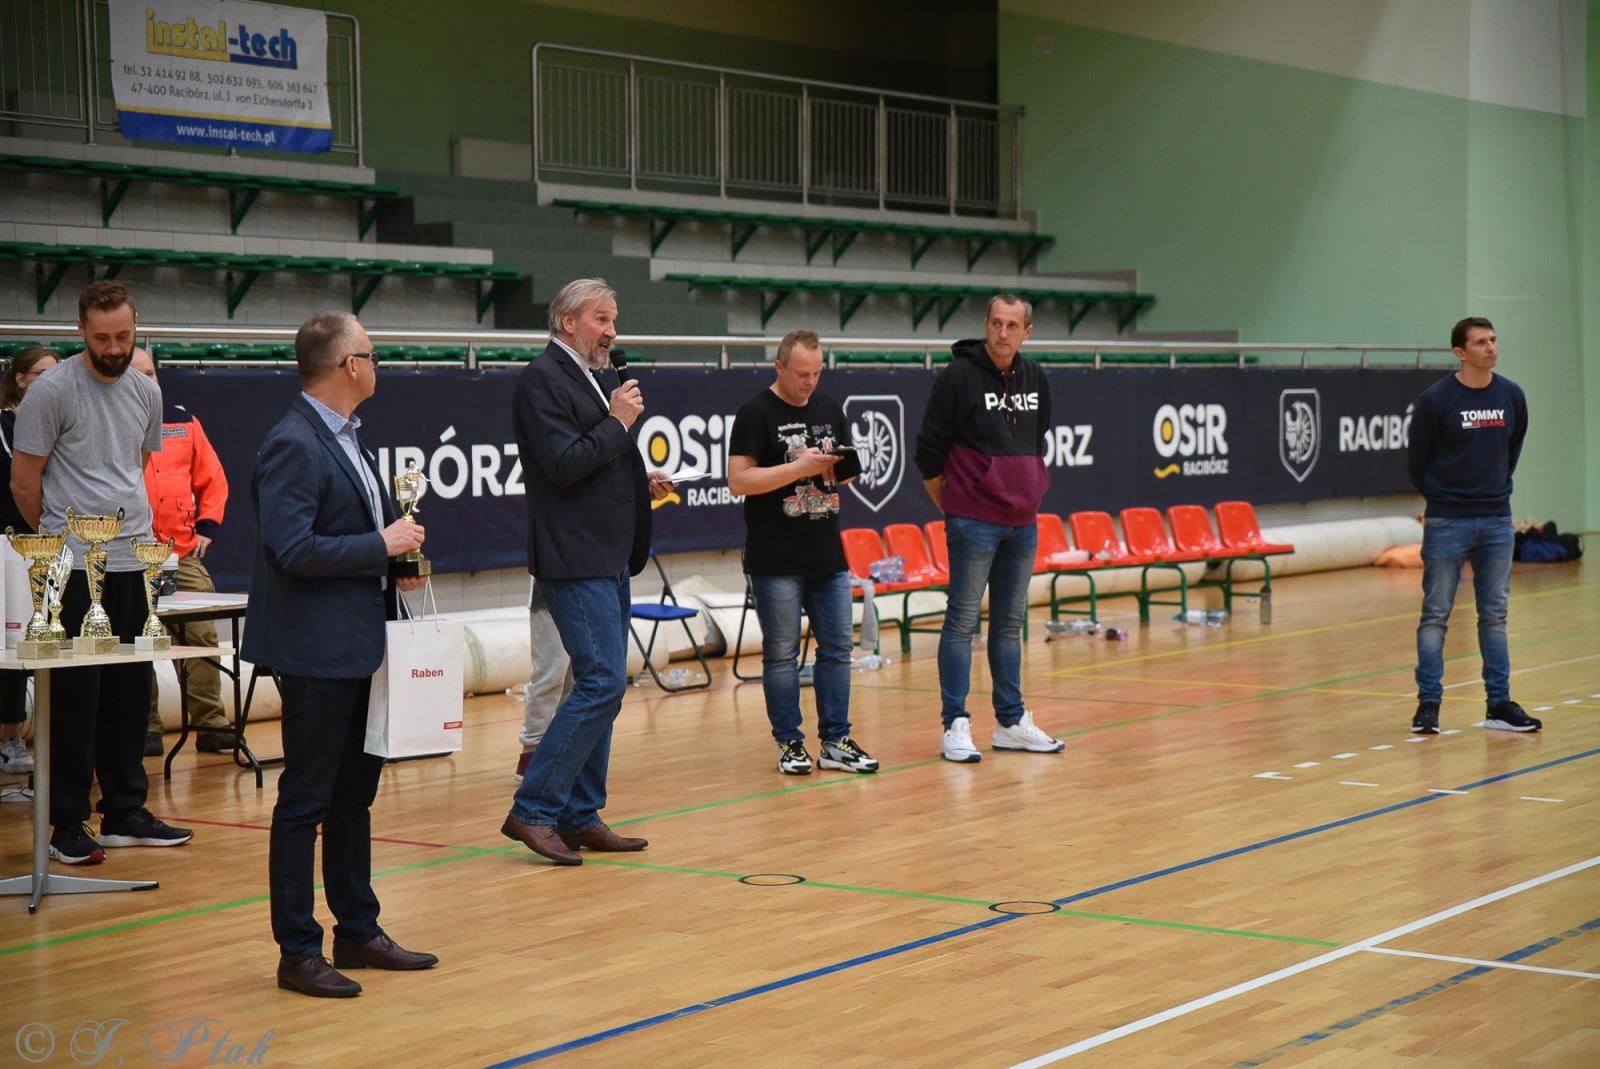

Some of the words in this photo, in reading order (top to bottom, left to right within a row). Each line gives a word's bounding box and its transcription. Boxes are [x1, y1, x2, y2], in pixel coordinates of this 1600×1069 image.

[145, 7, 297, 67] instal-tech
[123, 64, 138, 76] tel.
[140, 66, 152, 77] 32
[130, 82, 167, 97] 47-400
[307, 100, 313, 111] 2
[176, 124, 276, 146] www.instal-tech.pl
[984, 392, 1039, 411] PARIS
[1460, 409, 1504, 421] TOMMY
[637, 414, 736, 481] OSi
[411, 668, 444, 679] Raben
